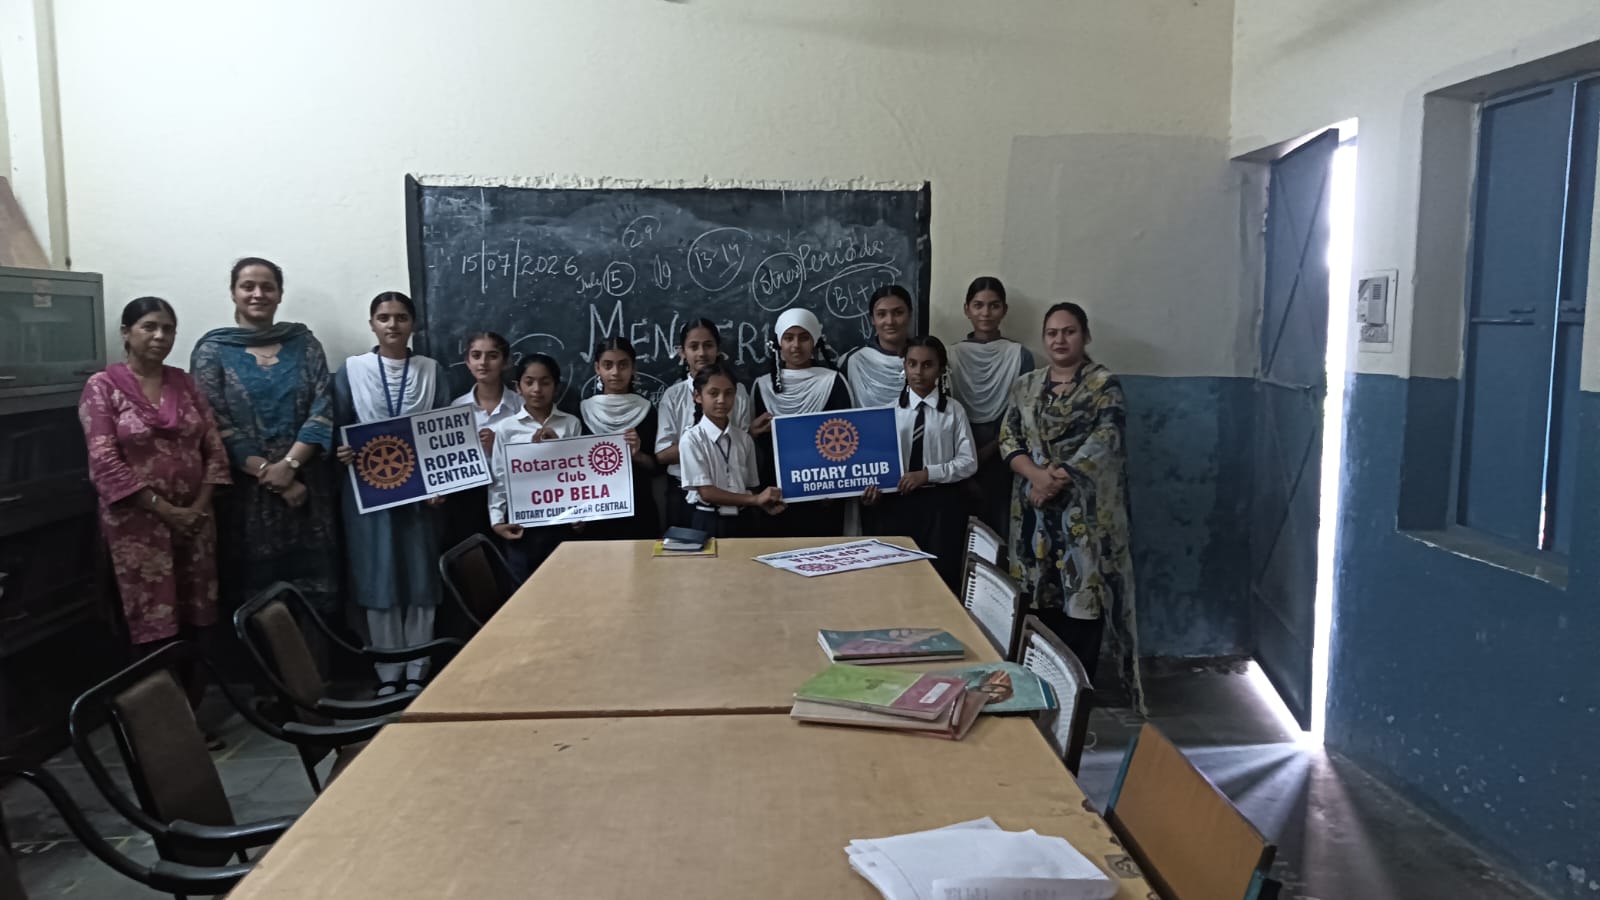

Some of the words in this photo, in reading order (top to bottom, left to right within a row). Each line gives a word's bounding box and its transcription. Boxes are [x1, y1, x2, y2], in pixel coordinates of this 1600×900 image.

[417, 411, 471, 435] ROTARY
[429, 431, 466, 450] CLUB
[424, 448, 480, 472] ROPAR
[511, 454, 585, 474] Rotaract
[427, 463, 486, 487] CENTRAL
[557, 471, 587, 483] Club
[791, 465, 848, 484] ROTARY
[852, 461, 890, 477] CLUB
[803, 480, 835, 492] ROPAR
[837, 476, 880, 489] CENTRAL
[531, 488, 564, 505] COP
[570, 484, 610, 501] BELA
[515, 509, 545, 520] ROTARY
[595, 501, 629, 512] CENTRAL
